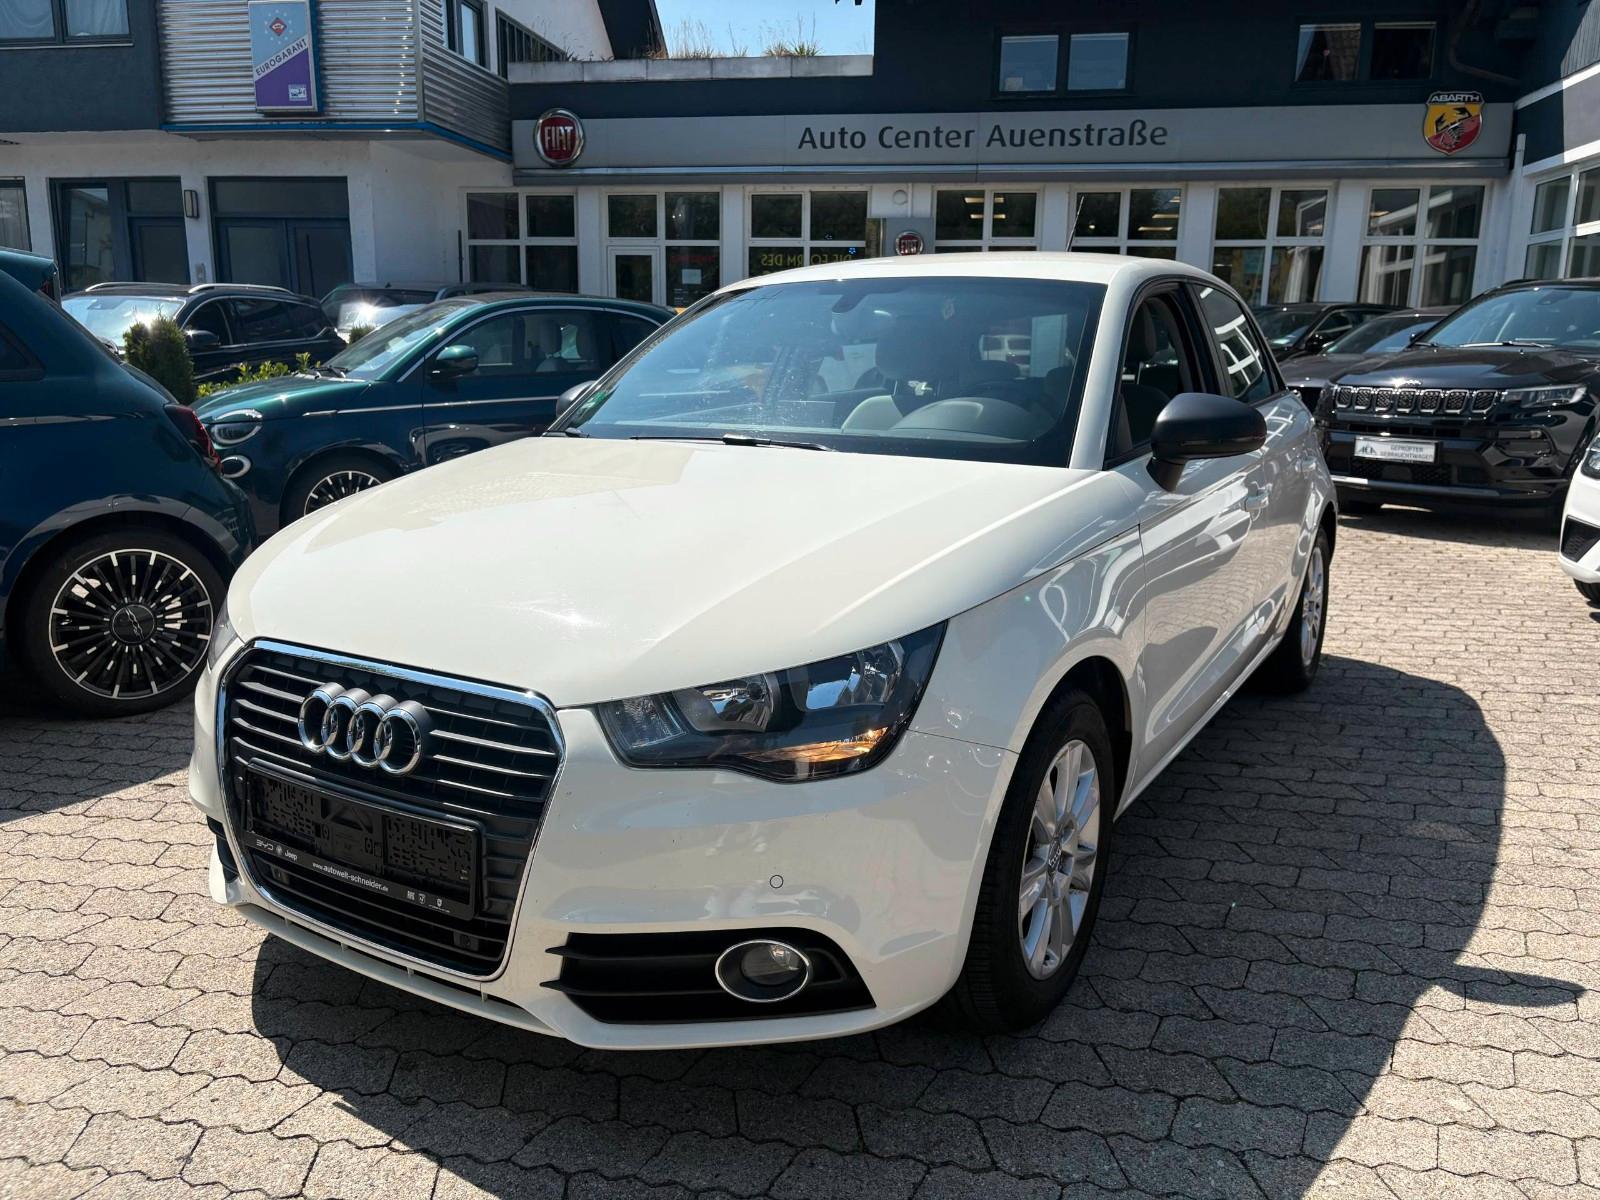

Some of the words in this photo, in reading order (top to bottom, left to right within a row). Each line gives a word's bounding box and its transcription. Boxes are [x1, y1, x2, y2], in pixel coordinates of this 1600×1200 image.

[255, 38, 307, 76] EUROGARANT
[1431, 94, 1480, 102] ABARTH
[544, 126, 574, 151] FIAT
[798, 127, 866, 149] Auto
[878, 126, 975, 149] Center
[985, 119, 1168, 148] Auenstraße
[900, 239, 918, 254] FIAT
[284, 849, 298, 861] Jeep
